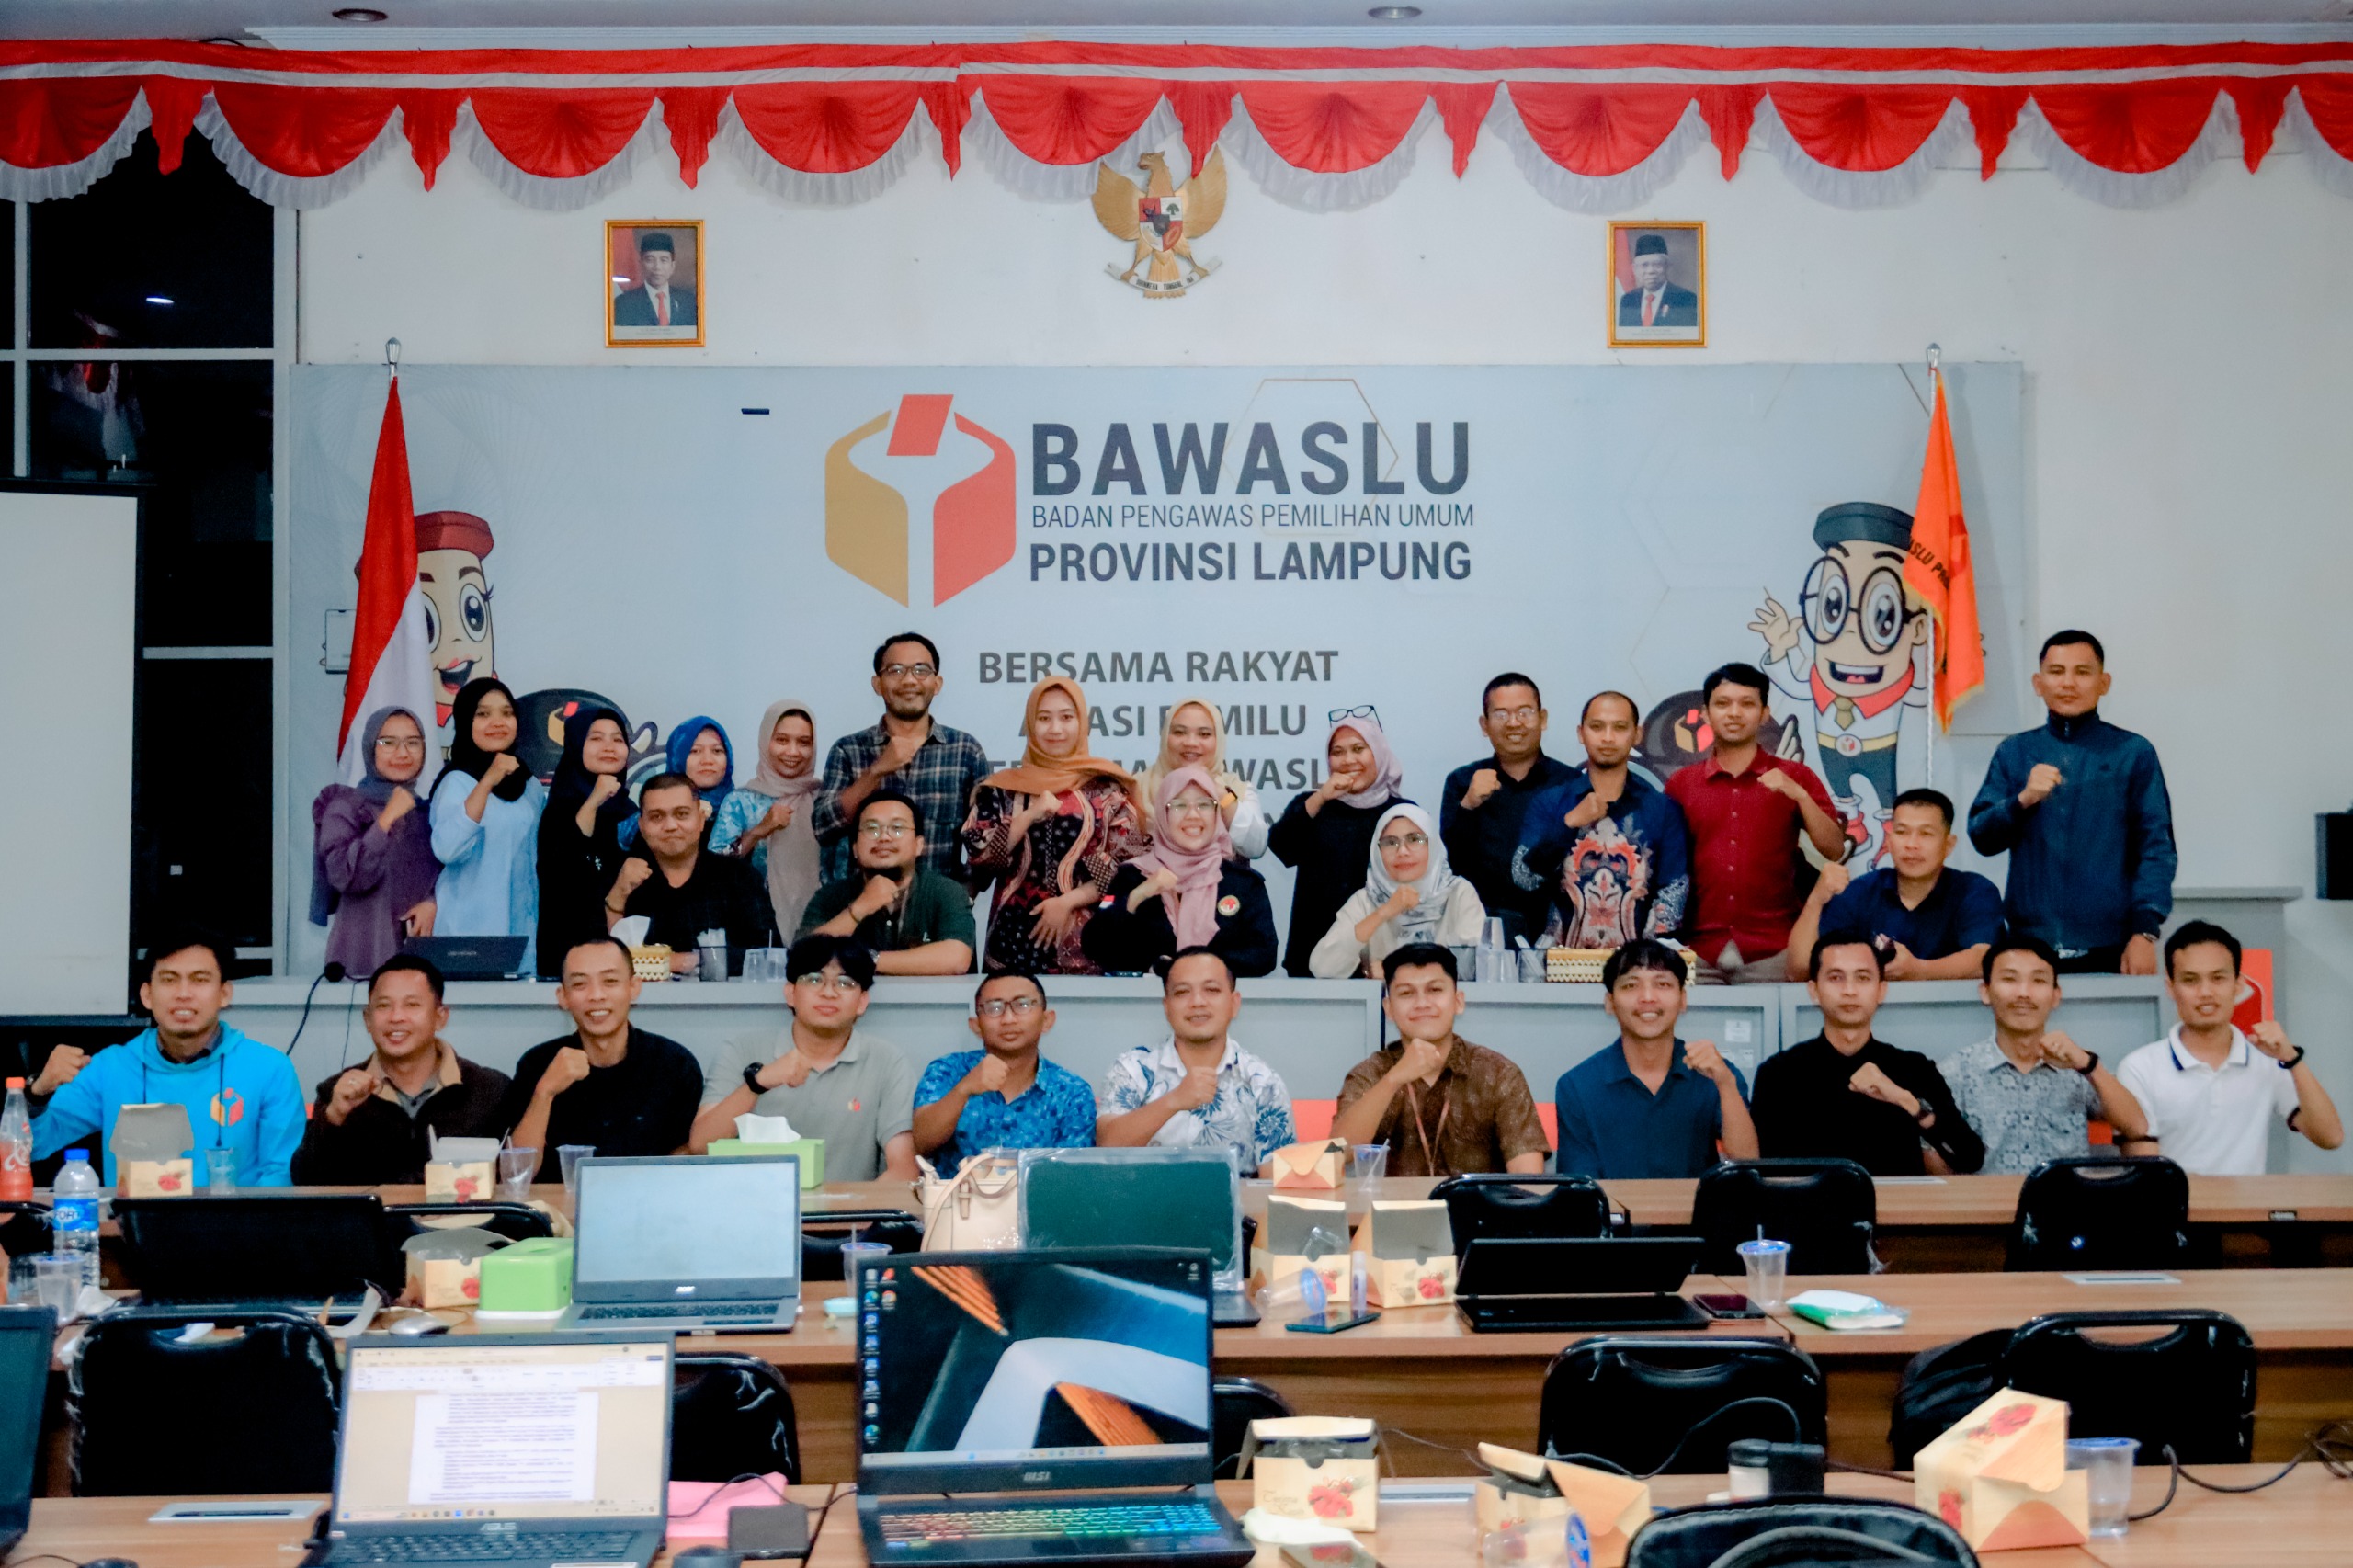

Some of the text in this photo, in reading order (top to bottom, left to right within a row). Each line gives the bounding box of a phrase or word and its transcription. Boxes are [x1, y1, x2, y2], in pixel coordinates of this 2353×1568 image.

[1032, 421, 1469, 496] BAWASLU
[1032, 503, 1474, 528] BADAN PENGAWAS PEMILIHAN UMUM
[1030, 541, 1471, 582] PROVINSI LAMPUNG
[979, 650, 1339, 684] BERSAMA RAKYAT
